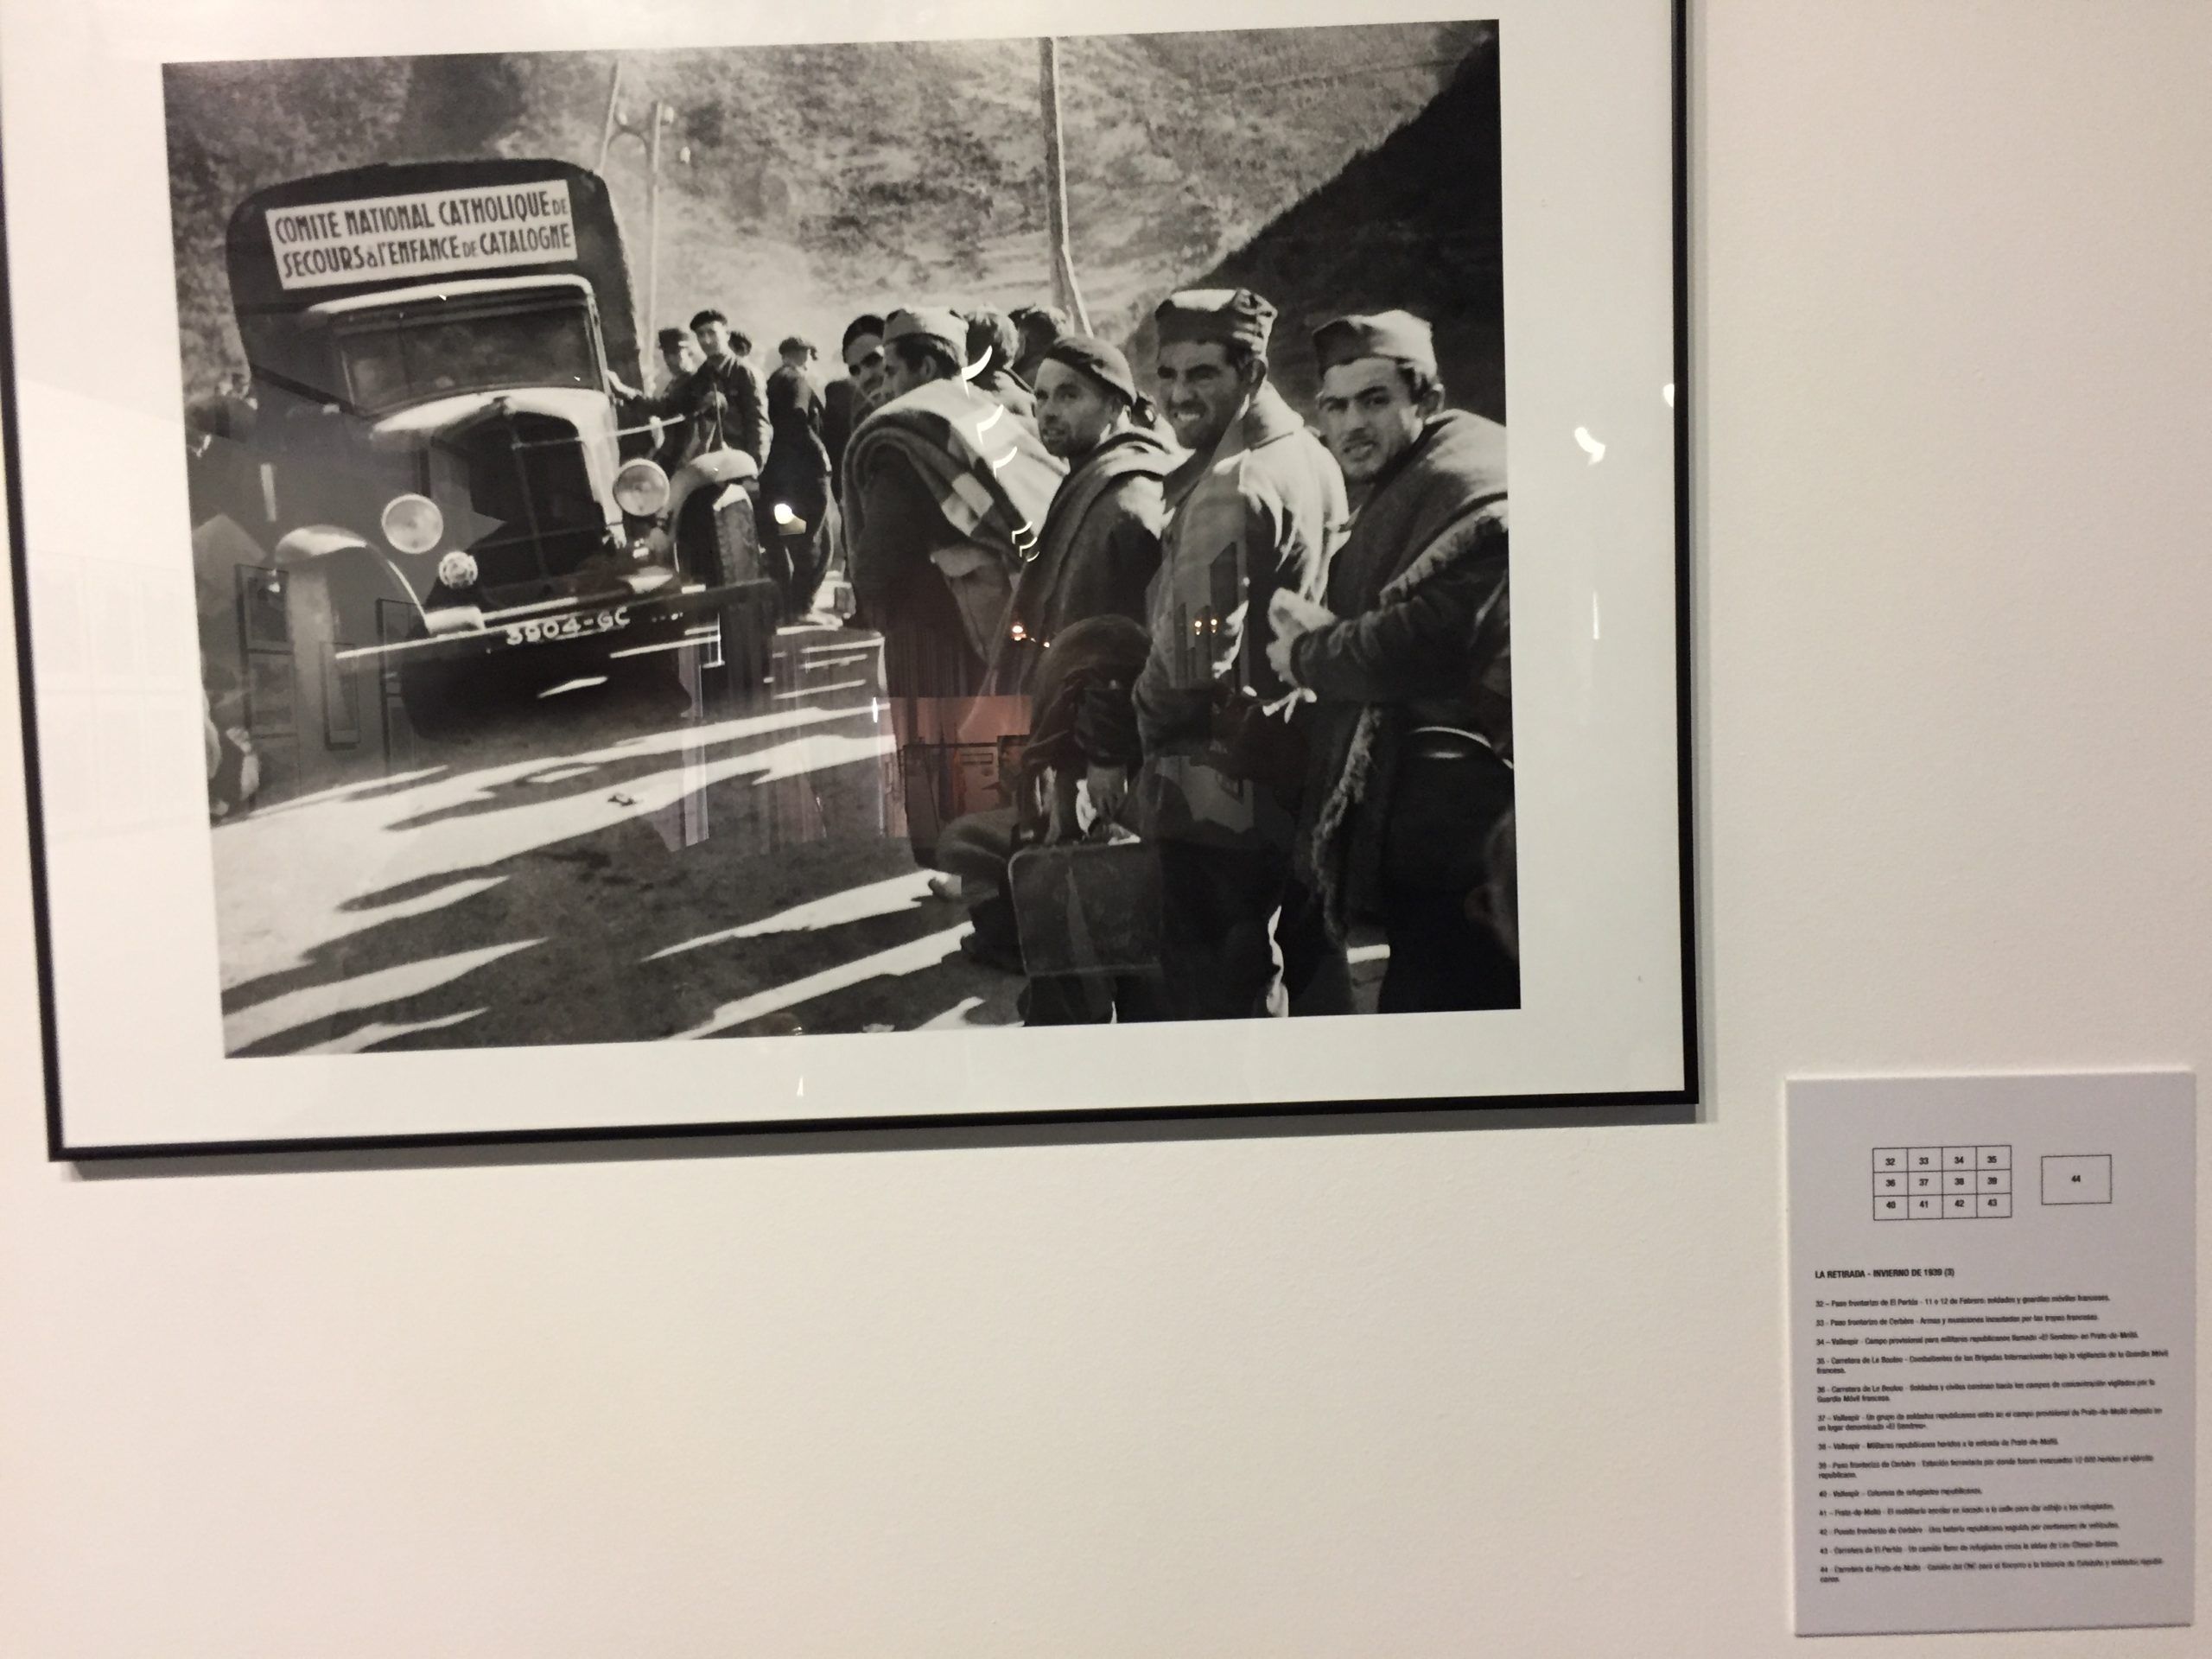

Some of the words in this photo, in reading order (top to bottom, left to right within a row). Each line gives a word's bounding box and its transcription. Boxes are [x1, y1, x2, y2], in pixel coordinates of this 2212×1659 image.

[344, 202, 435, 237] NATIONAL
[438, 191, 550, 226] CATHOLIQUE
[552, 199, 568, 216] DE
[283, 245, 365, 278] SECOURS
[480, 223, 571, 256] CATALOGNE
[1885, 1157, 1896, 1166] 32
[1919, 1157, 1929, 1166] 33
[1954, 1156, 1964, 1165] 34
[1986, 1155, 1998, 1164] 35
[1885, 1179, 1896, 1188] 36
[1919, 1178, 1929, 1186] 37
[1987, 1177, 1998, 1185] 39
[2071, 1175, 2081, 1184] 44
[1885, 1200, 1896, 1210] 40
[1919, 1200, 1929, 1209] 41
[1955, 1199, 1965, 1208] 42
[1987, 1198, 1998, 1207] 43
[1872, 1268, 1910, 1277] INVIERNO
[1944, 1268, 1955, 1277] (3)
